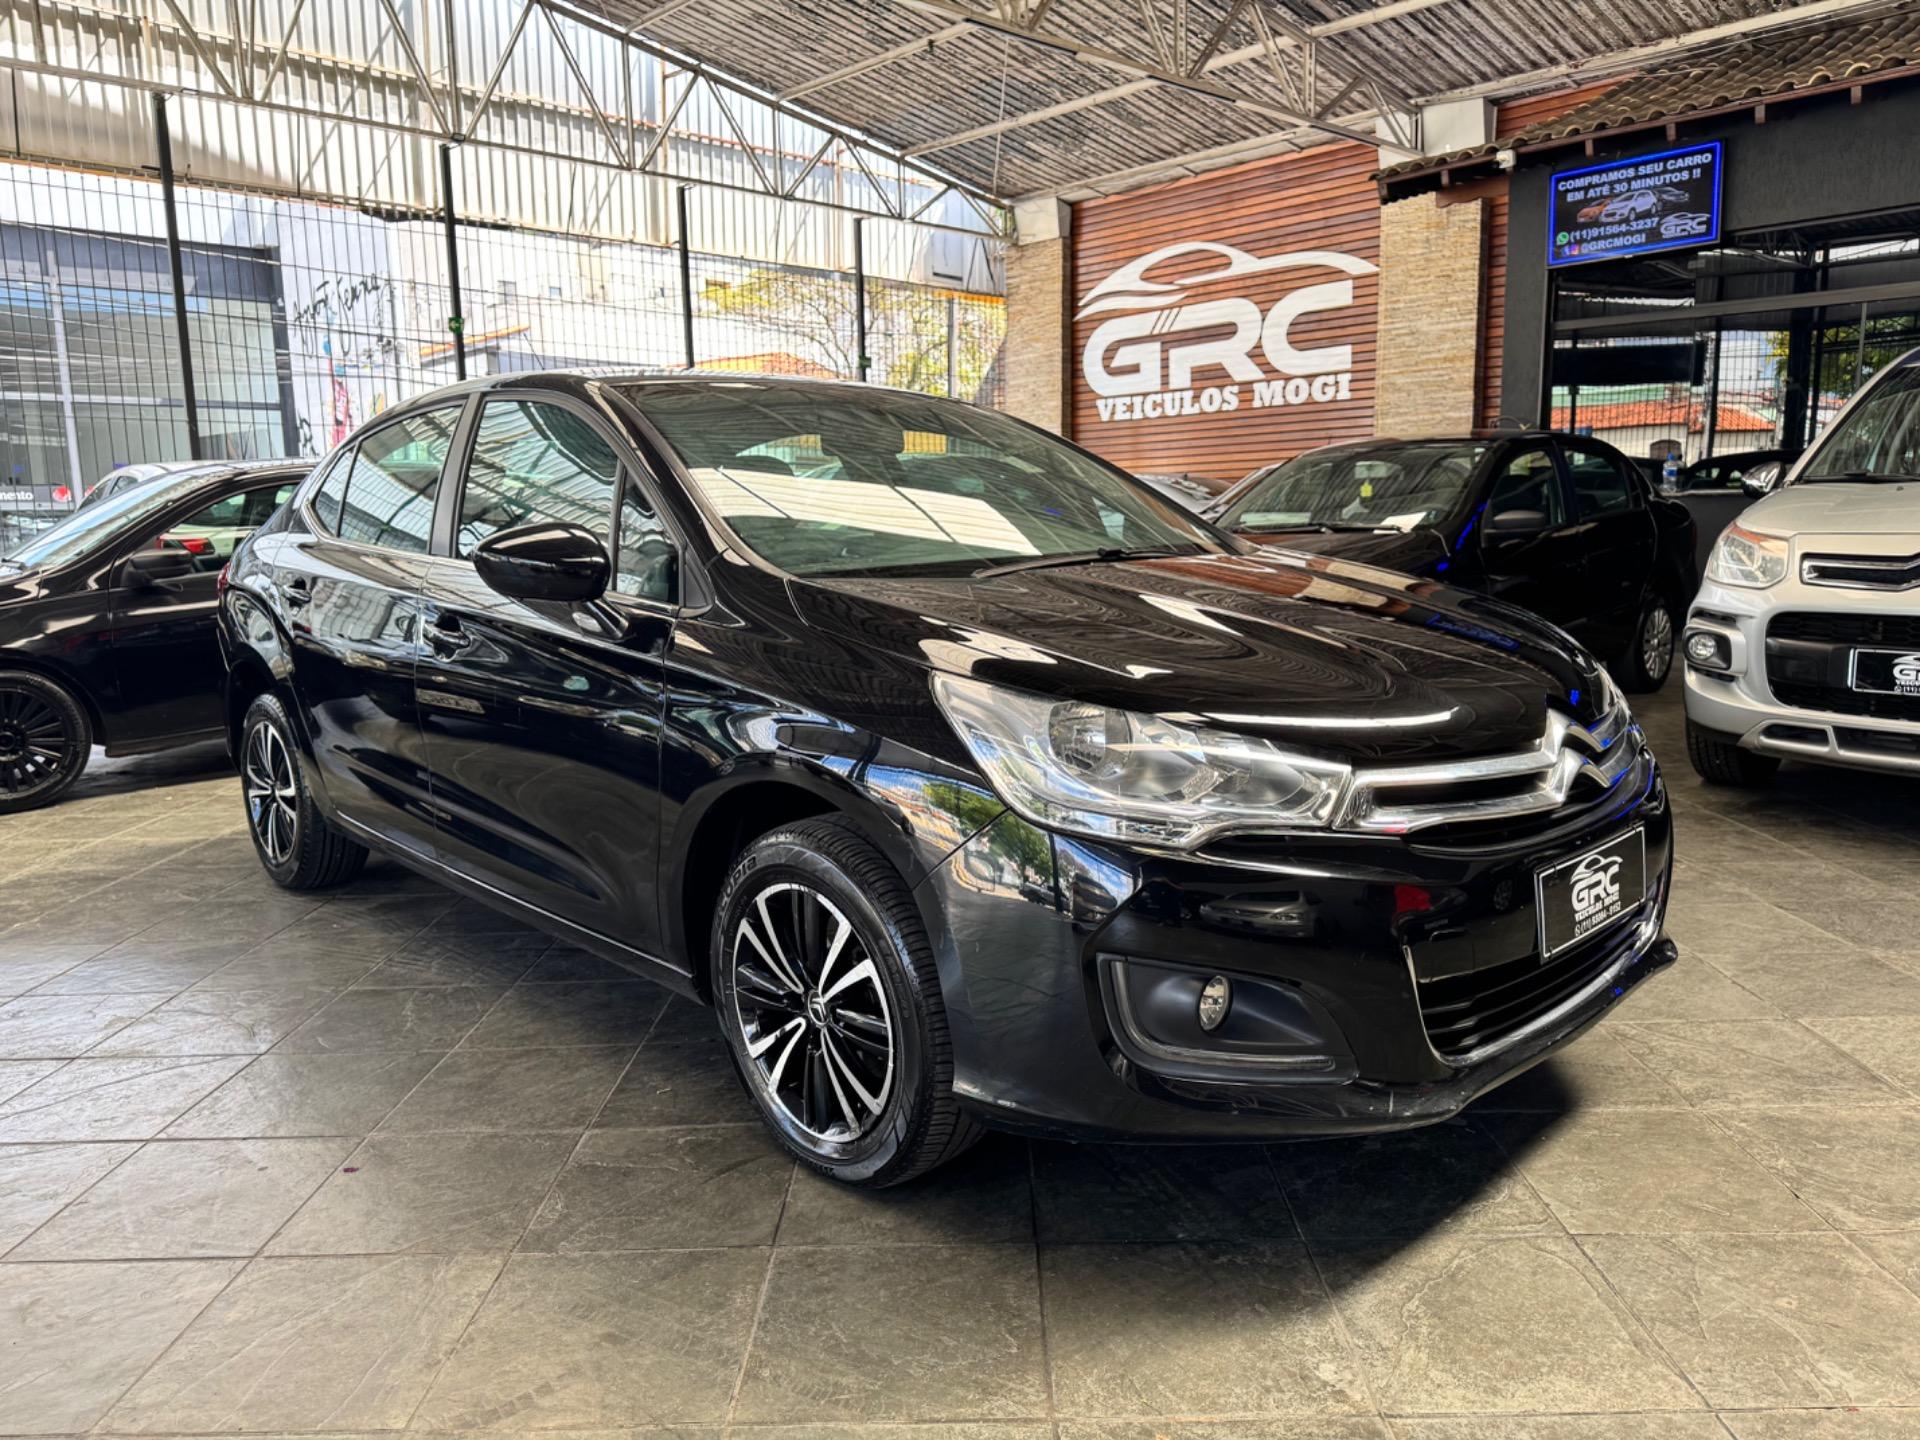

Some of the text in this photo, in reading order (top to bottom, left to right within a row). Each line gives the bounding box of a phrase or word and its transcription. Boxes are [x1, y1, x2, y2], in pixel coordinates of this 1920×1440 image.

[1558, 153, 1713, 191] COMPRAMOS SEU CARRO
[1566, 191, 1585, 203] EM
[1587, 183, 1610, 199] ATÉ
[1613, 181, 1629, 194] 30
[1631, 169, 1690, 191] MINUTOS
[1660, 217, 1708, 235] GRC
[1082, 278, 1354, 398] GRC
[1096, 373, 1352, 422] VEICULOS MOGI
[1571, 863, 1620, 912] GRC
